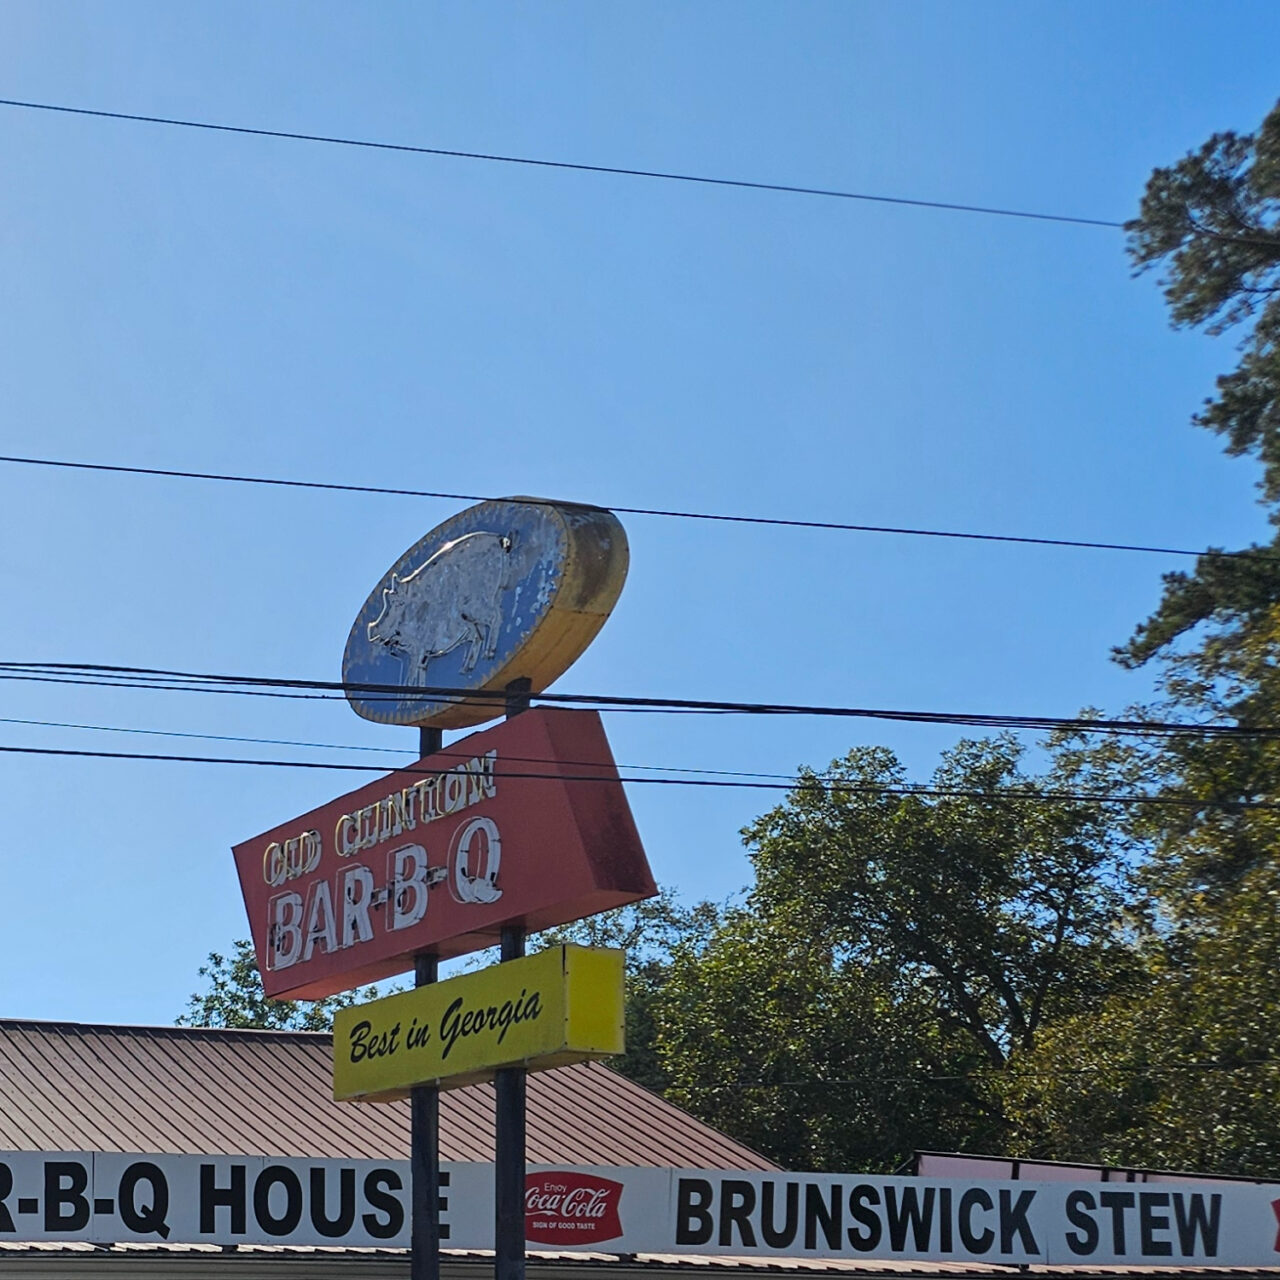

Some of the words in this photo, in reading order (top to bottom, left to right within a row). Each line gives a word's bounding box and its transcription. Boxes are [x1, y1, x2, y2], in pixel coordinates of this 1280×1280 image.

[263, 829, 322, 887] OLD
[335, 749, 497, 857] CLINTON
[266, 816, 503, 971] BAR-B-Q
[349, 1020, 400, 1063] Best
[406, 1018, 431, 1050] in
[439, 988, 544, 1060] Georgia
[544, 1183, 567, 1193] Enjoy
[577, 1222, 595, 1230] TASTE
[676, 1178, 1039, 1255] BRUNSWICK
[1065, 1191, 1222, 1257] STEW
